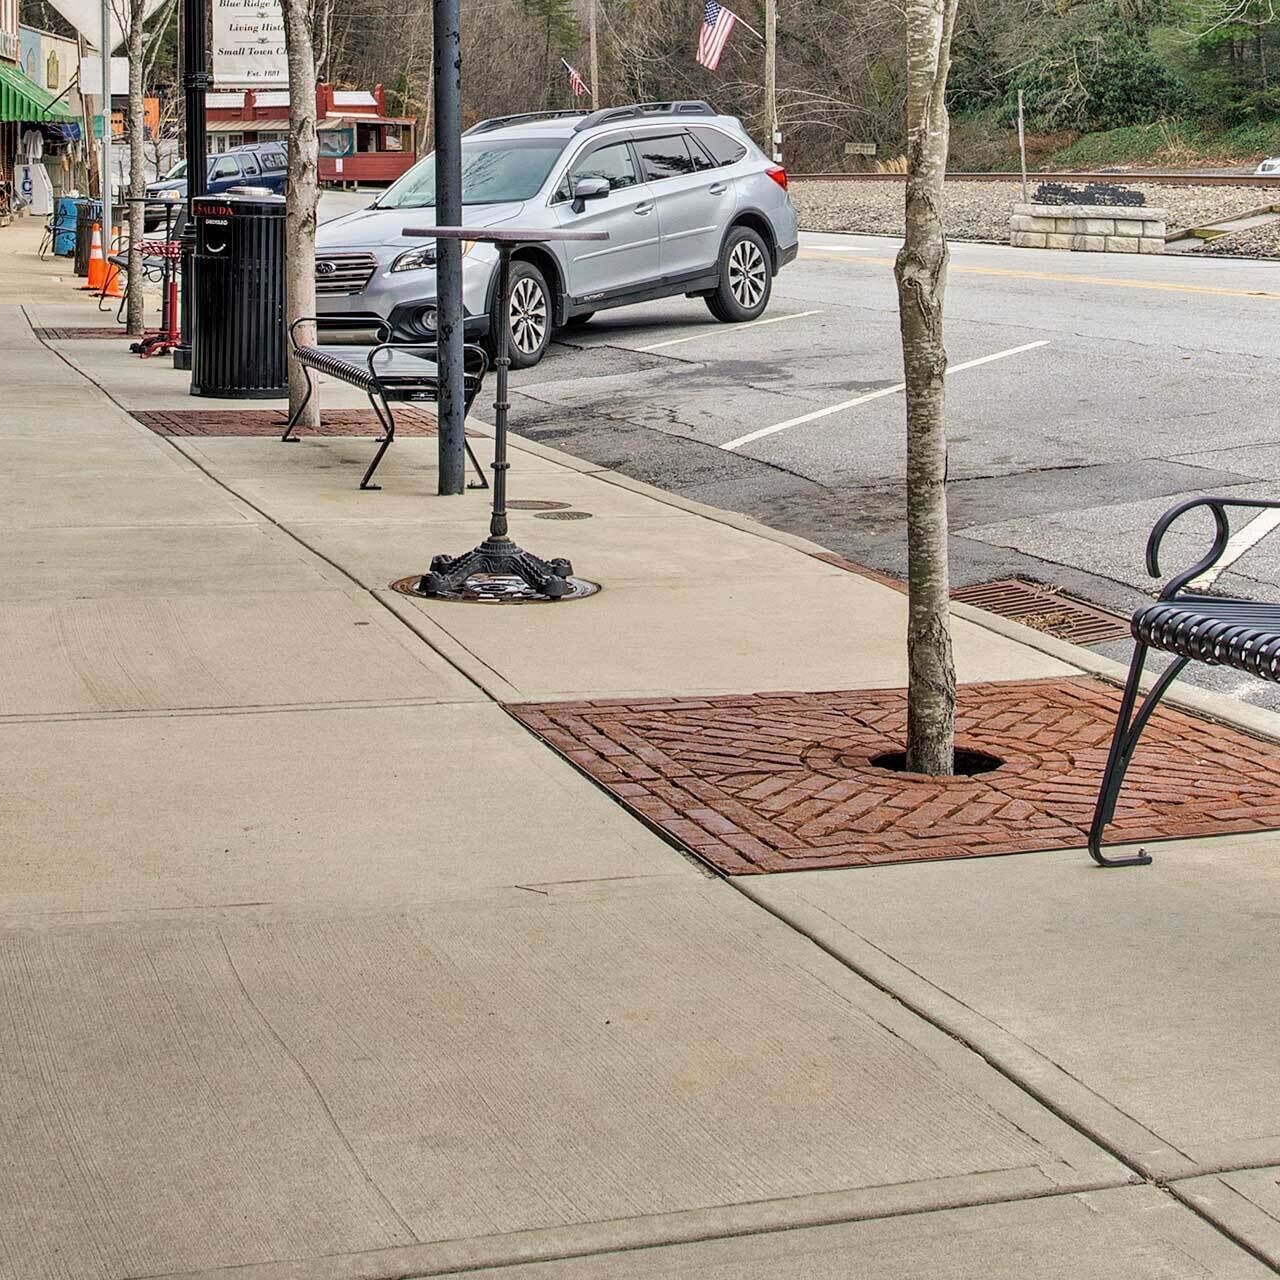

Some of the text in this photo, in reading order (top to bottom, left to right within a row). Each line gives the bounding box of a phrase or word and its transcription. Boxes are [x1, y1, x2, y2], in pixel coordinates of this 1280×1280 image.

[219, 0, 241, 8] Blue
[243, 0, 270, 9] Ridge
[229, 24, 259, 33] Living
[217, 47, 245, 56] Small
[247, 47, 273, 56] Town
[197, 205, 234, 215] SALUDA
